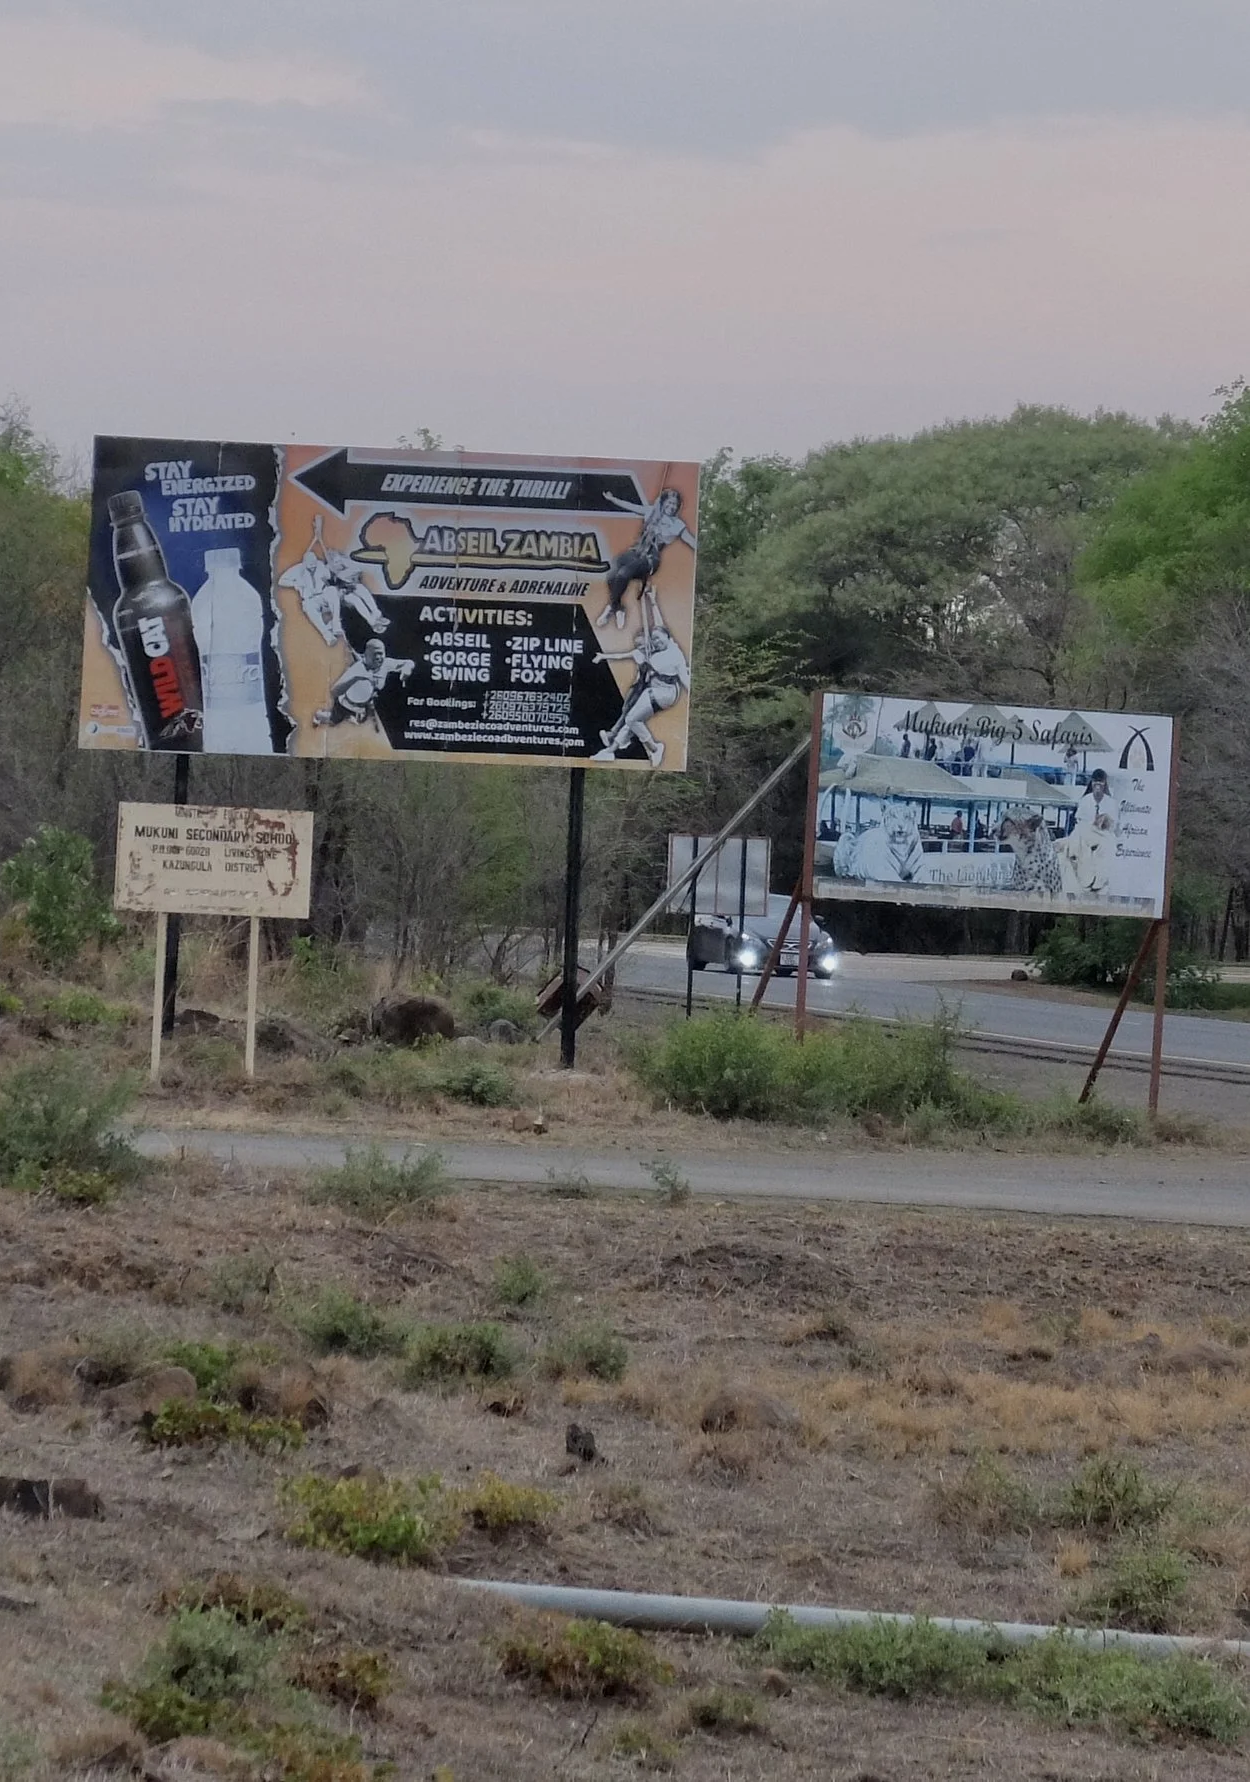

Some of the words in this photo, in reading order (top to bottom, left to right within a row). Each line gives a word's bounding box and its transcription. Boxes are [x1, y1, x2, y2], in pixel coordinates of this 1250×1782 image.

[144, 460, 193, 481] STAY
[161, 475, 256, 496] ENERGIZED
[380, 473, 479, 496] EXPERIENCE
[477, 476, 511, 497] THE
[509, 479, 573, 499] THRILL!
[172, 496, 221, 517] STAY
[168, 512, 256, 533] HYDRATED
[424, 527, 498, 555] ABSEIL
[503, 531, 599, 561] ZAMBIA
[419, 575, 498, 593] ADVENTURE
[498, 581, 508, 594] &
[508, 579, 590, 597] ADRENALINE
[419, 606, 534, 627] ACTIVITIES:
[137, 616, 170, 658] CAT
[429, 632, 492, 649] ABSEIL
[511, 636, 541, 651] ZIP
[544, 638, 584, 654] LINE
[430, 650, 492, 667] GORGE
[511, 653, 574, 671] FLYING
[431, 666, 491, 683] SWING
[510, 668, 547, 684] FOX
[149, 656, 184, 719] WILD
[407, 697, 425, 706] For
[426, 697, 477, 710] Bookings:
[409, 718, 579, 735] res@zambeziecoadventures.com
[903, 710, 970, 738] Mukuni
[975, 715, 1007, 746] Big
[1029, 719, 1093, 750] Safaris
[134, 825, 179, 840] MUKUNI
[186, 828, 249, 844] SECONDARY
[162, 860, 213, 873] KAZUNGULA
[224, 862, 264, 874] DISTRICT
[929, 868, 953, 882] The
